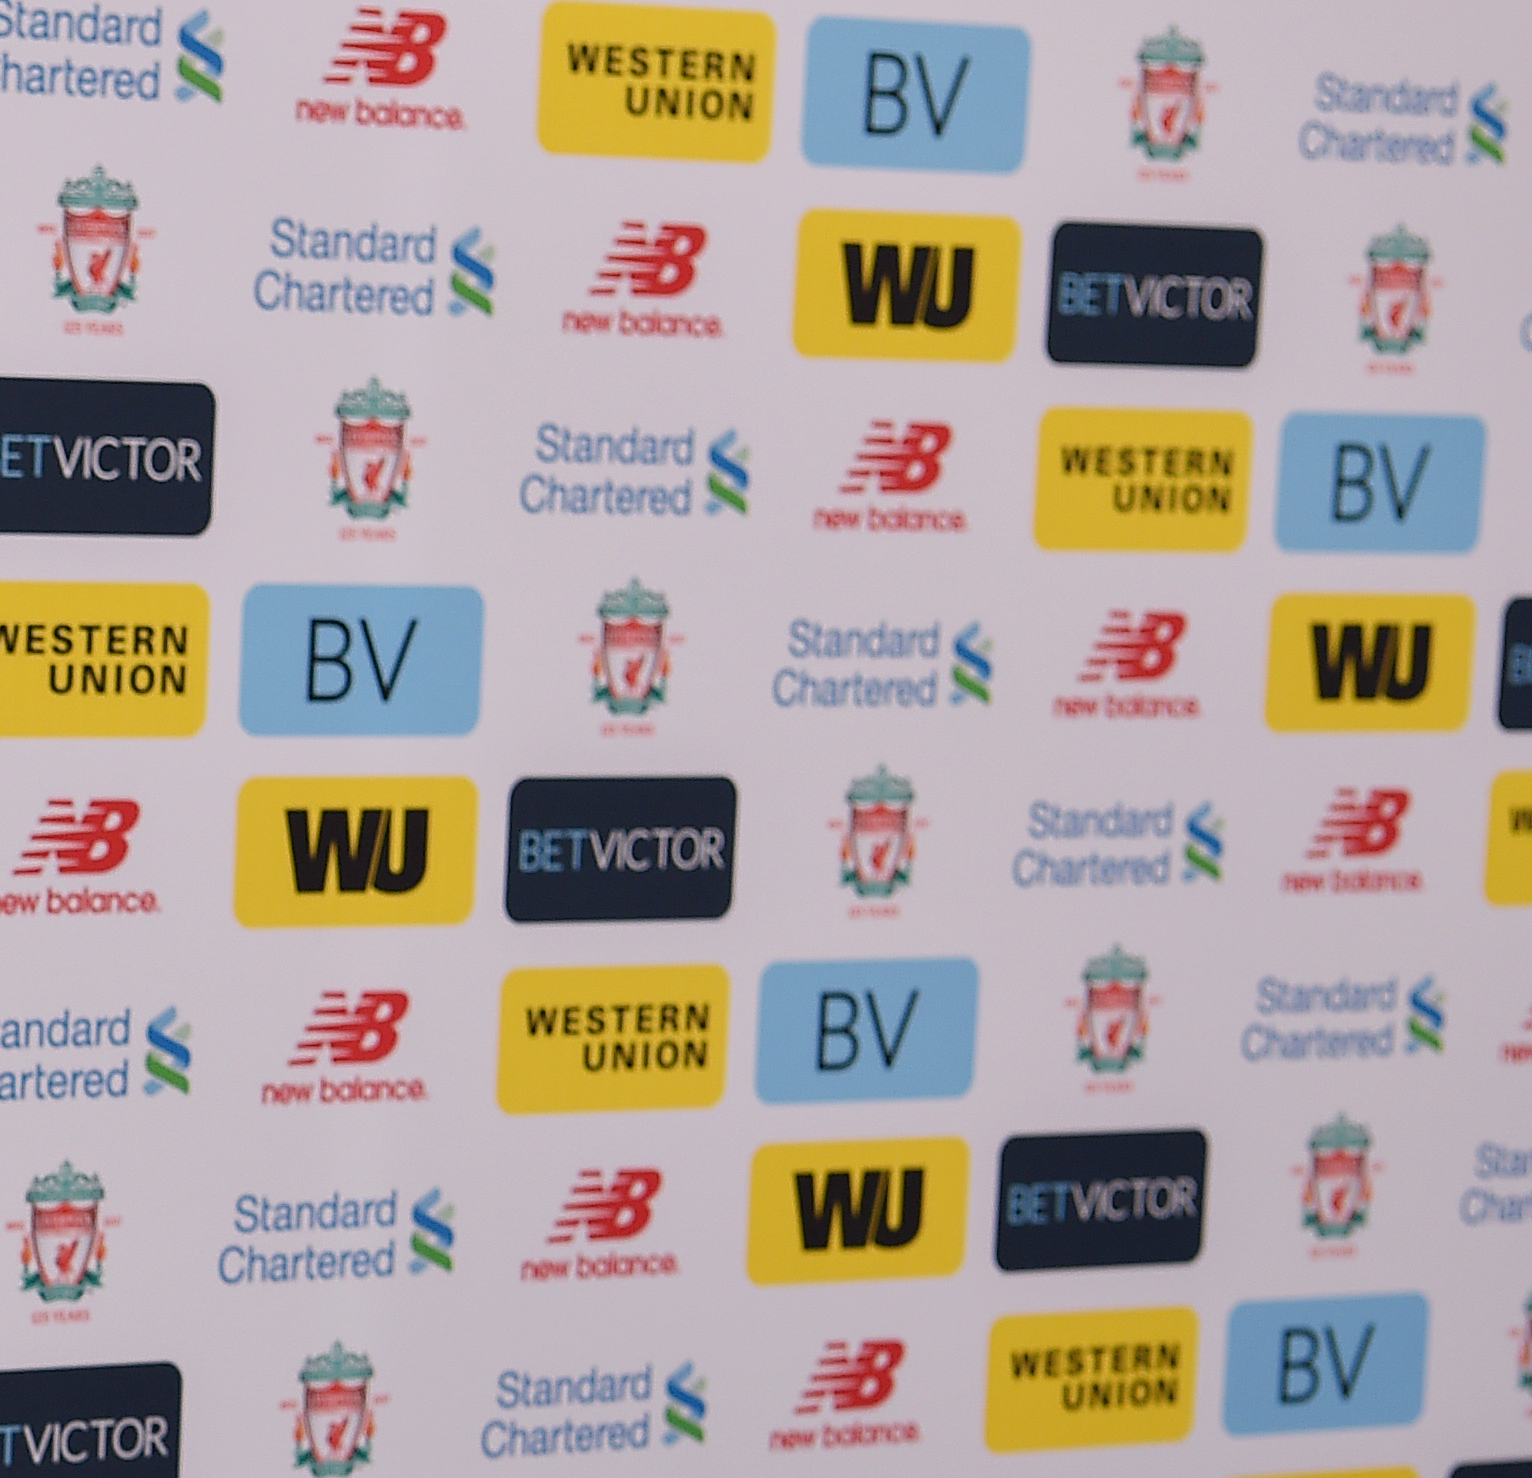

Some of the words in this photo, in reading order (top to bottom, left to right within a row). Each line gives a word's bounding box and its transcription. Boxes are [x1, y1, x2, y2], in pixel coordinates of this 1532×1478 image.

[568, 44, 755, 82] WESTERN
[626, 87, 752, 121] UNION
[864, 51, 969, 137] BV
[843, 243, 974, 330] WU
[1060, 273, 1251, 319] BETVICTOR
[1062, 447, 1232, 477] WESTERN
[1332, 443, 1430, 523] BV
[1114, 485, 1230, 513] UNION
[307, 618, 417, 702] BV
[789, 620, 939, 658] Standard
[50, 664, 185, 694] UNION
[1313, 625, 1431, 701] WU
[772, 669, 936, 707] Chartered
[286, 809, 428, 894] WU
[520, 827, 724, 871] BETVICTOR
[527, 1004, 709, 1036] WESTERN
[816, 990, 918, 1072] BV
[584, 1040, 707, 1072] UNION
[795, 1168, 923, 1250] WU
[1008, 1177, 1196, 1223] BETVICTOR
[1012, 1344, 1179, 1378] WESTERN
[1278, 1325, 1374, 1405] BV
[497, 1368, 651, 1408] Standard
[1063, 1378, 1177, 1410] UNION
[480, 1414, 650, 1458] Chartered
